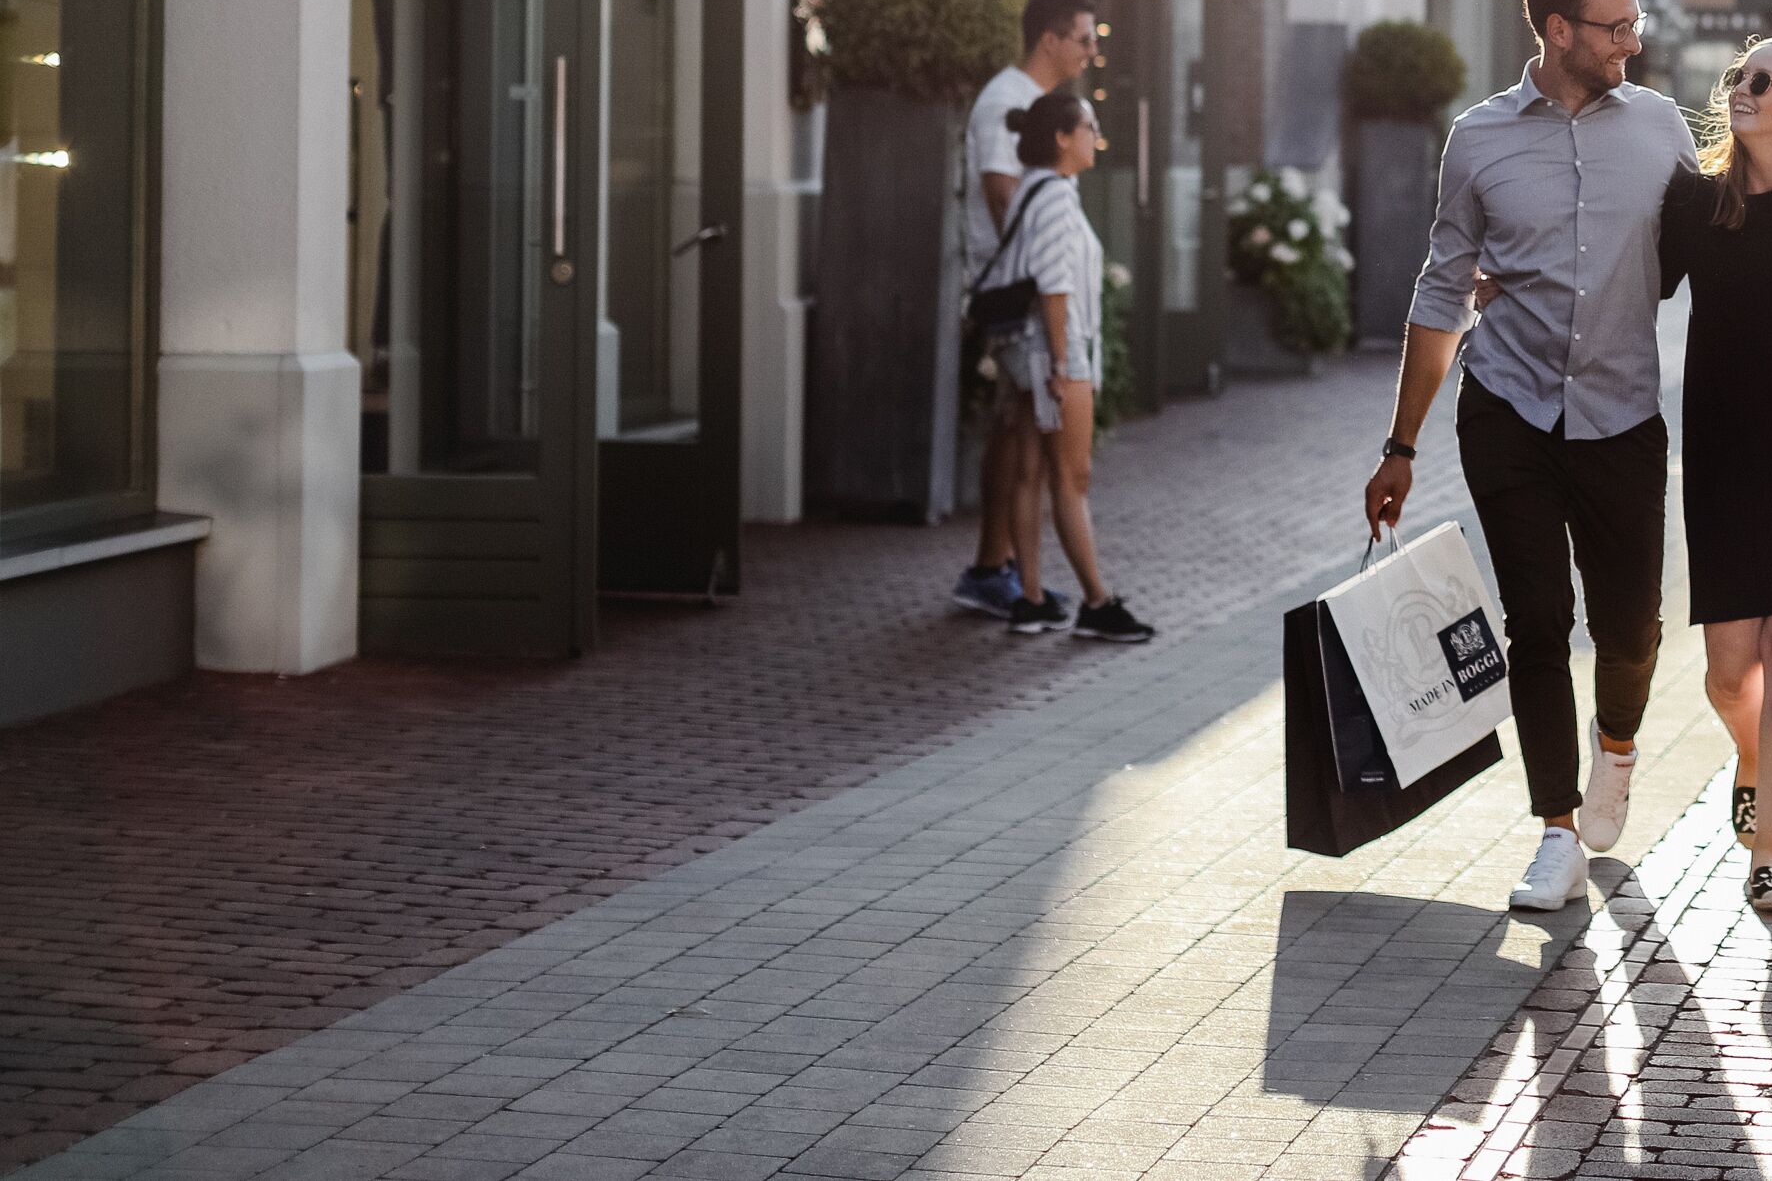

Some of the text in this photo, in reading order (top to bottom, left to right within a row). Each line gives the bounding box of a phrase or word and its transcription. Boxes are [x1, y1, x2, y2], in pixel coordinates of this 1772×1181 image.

[1408, 650, 1500, 716] MADE IN BOGGI
